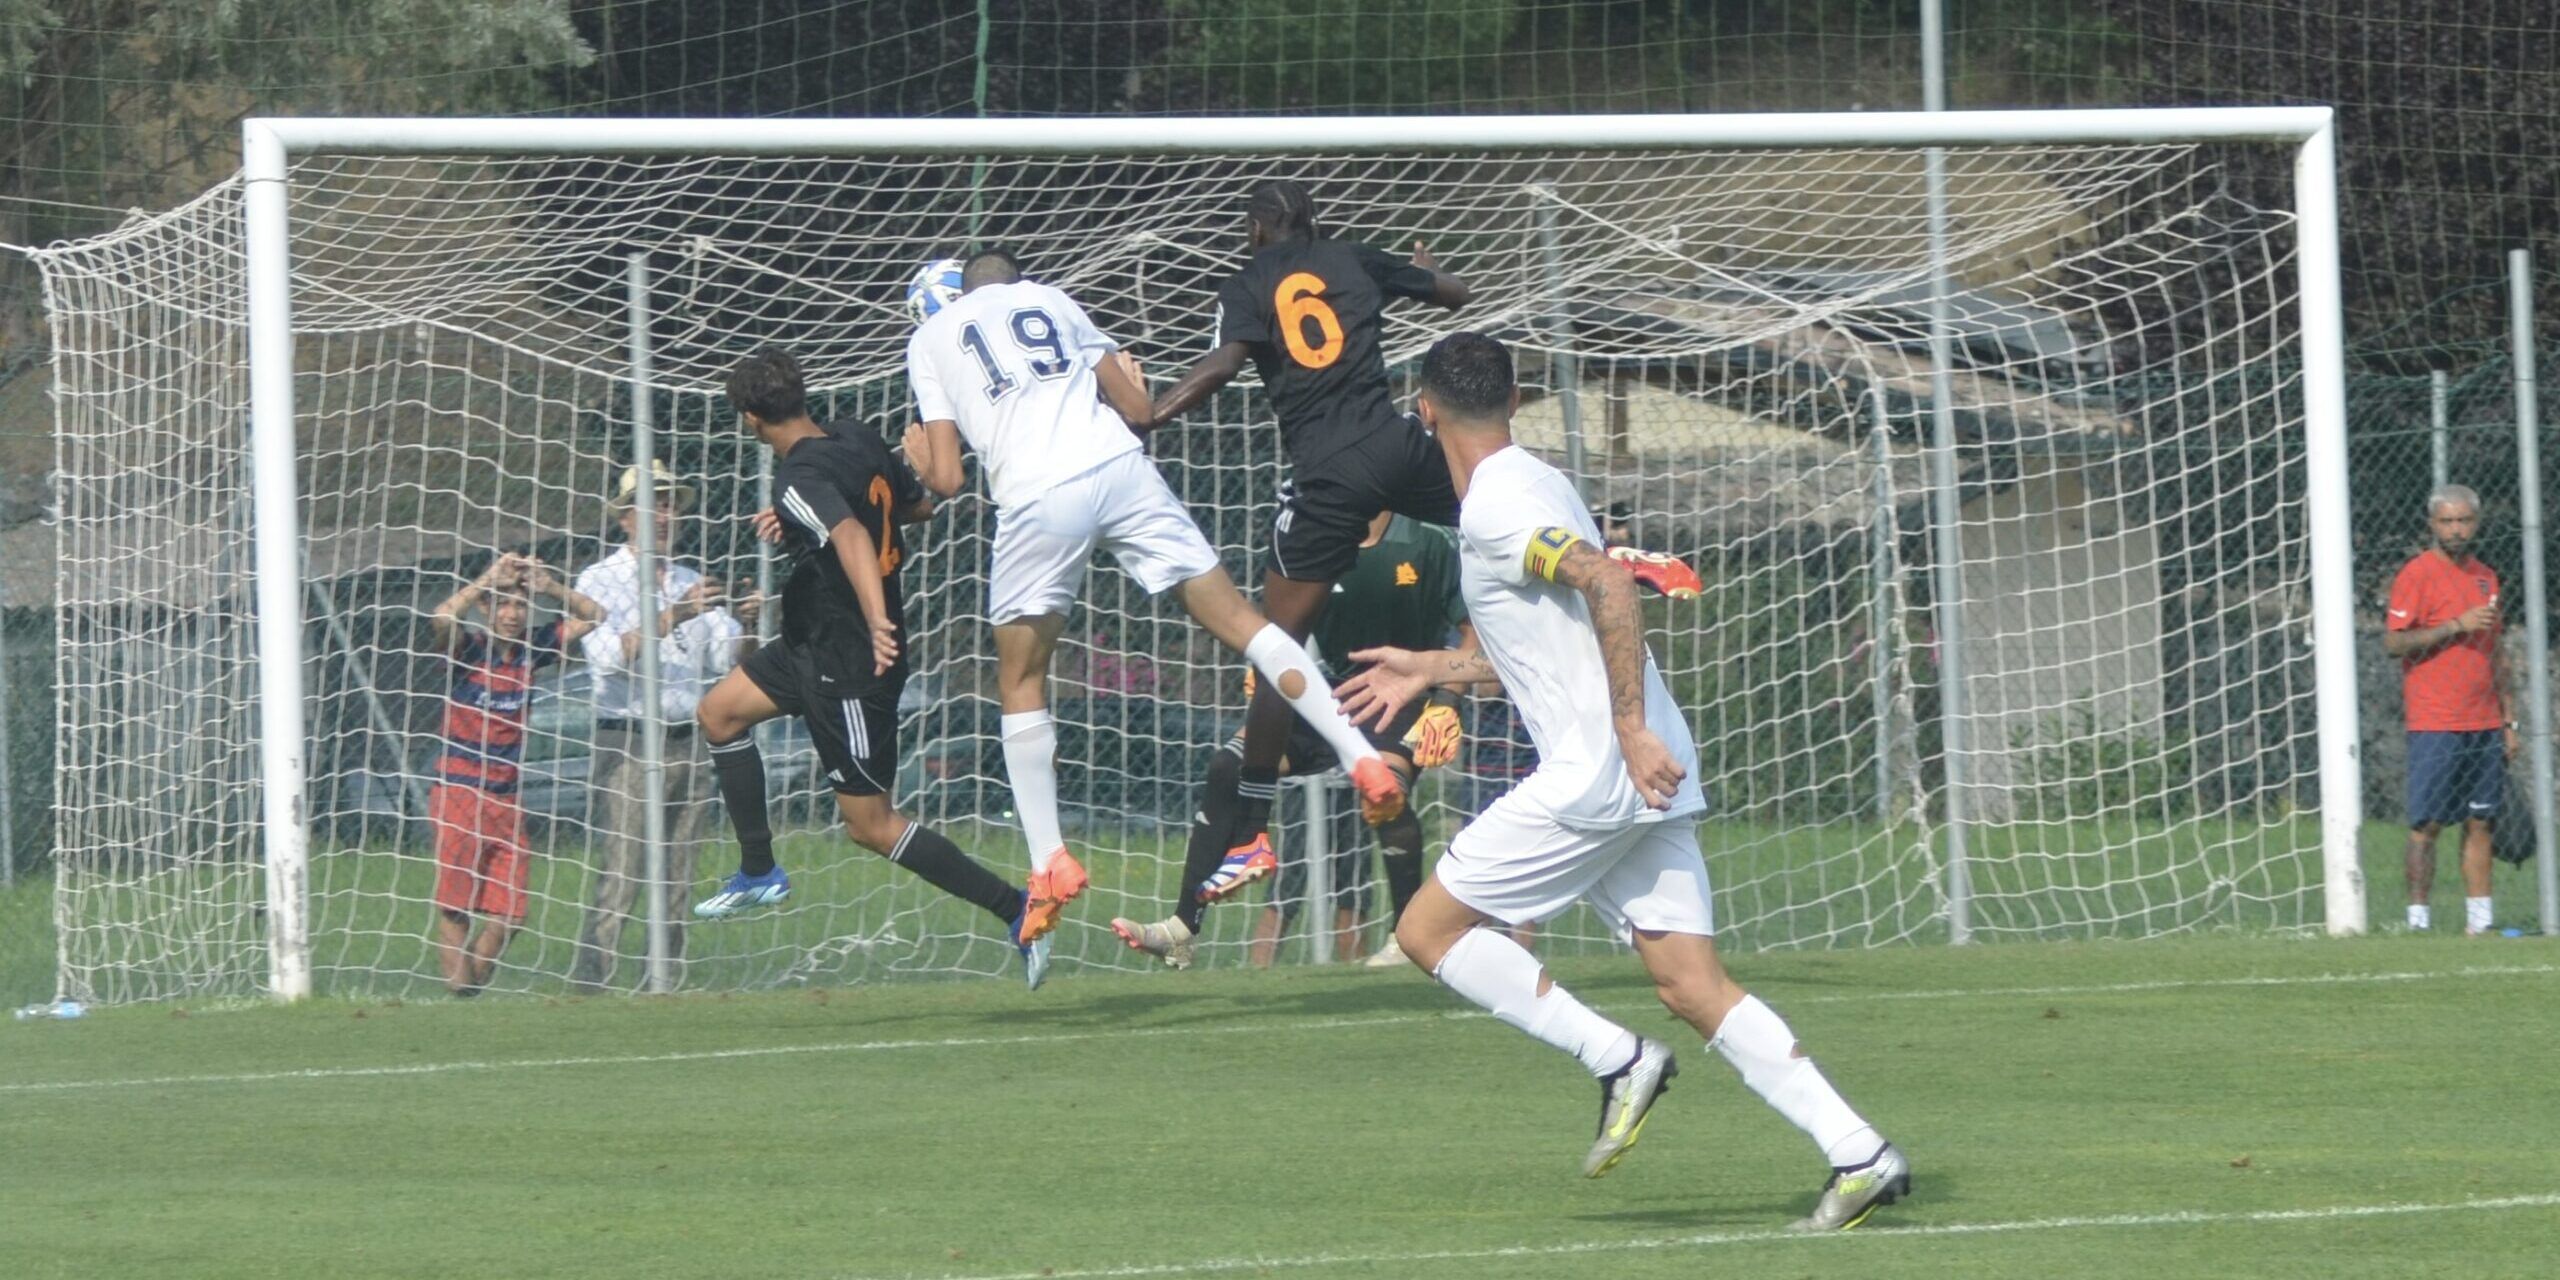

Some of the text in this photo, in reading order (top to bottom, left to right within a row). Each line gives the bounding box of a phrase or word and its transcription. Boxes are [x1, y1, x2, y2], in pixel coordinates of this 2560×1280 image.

[957, 306, 1075, 405] 19
[1274, 272, 1344, 369] 6
[868, 474, 899, 578] 2
[1538, 526, 1571, 550] C
